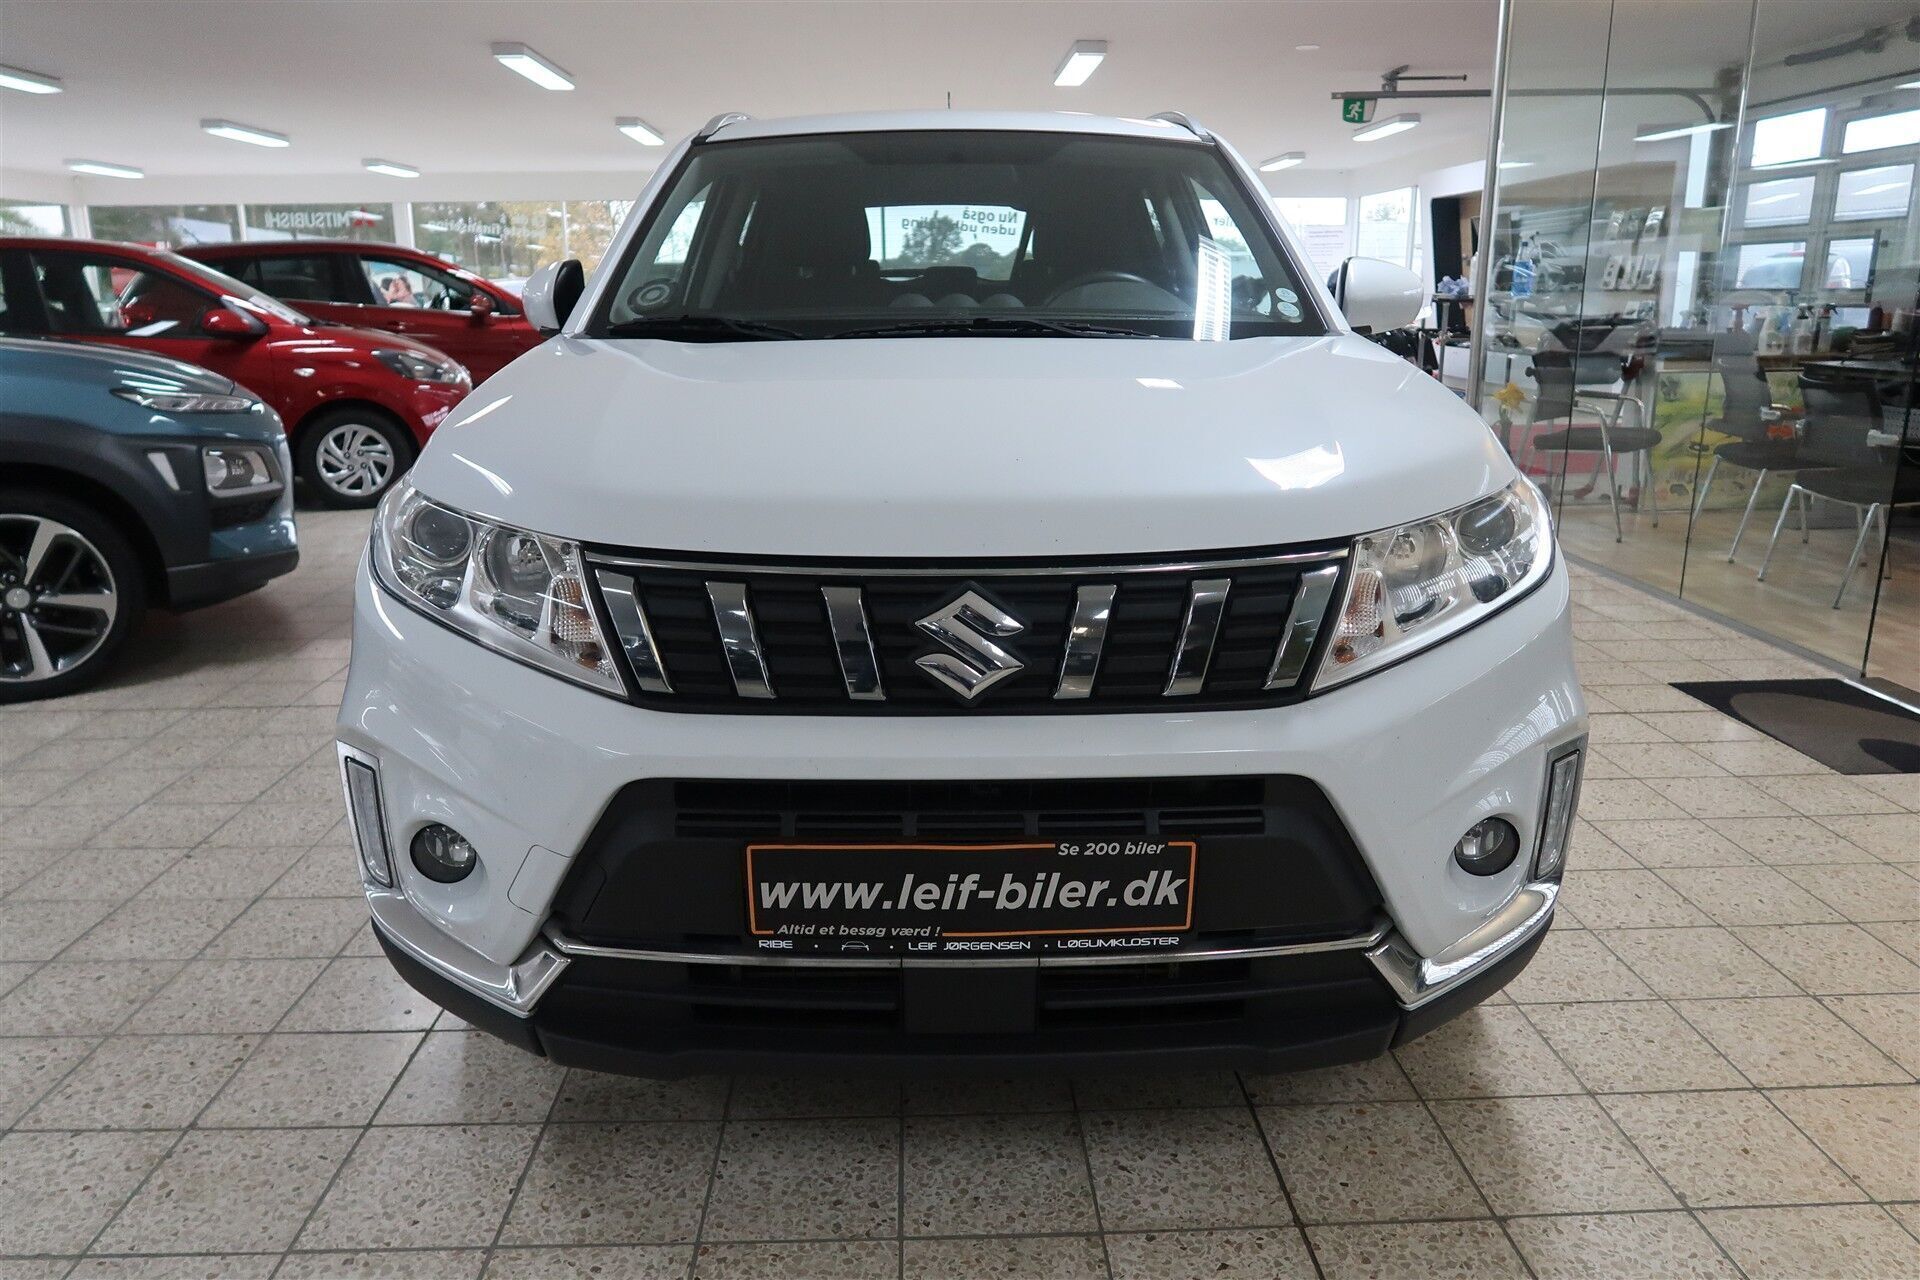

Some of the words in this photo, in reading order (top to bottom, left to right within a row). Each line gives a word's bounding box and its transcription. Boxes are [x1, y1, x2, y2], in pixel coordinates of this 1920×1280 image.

[1058, 843, 1080, 856] Se
[1084, 842, 1120, 855] 200
[1124, 842, 1165, 855] biler
[760, 870, 1187, 910] www.leif-biler.dk
[777, 924, 815, 935] Altid
[819, 925, 835, 935] et
[839, 925, 886, 937] besøg
[891, 926, 932, 937] værd
[758, 939, 793, 949] RIBE
[908, 941, 937, 951] LEIF
[943, 940, 1031, 951] JØRGENSEN
[1057, 937, 1179, 949] LØGUMKLOSTER
